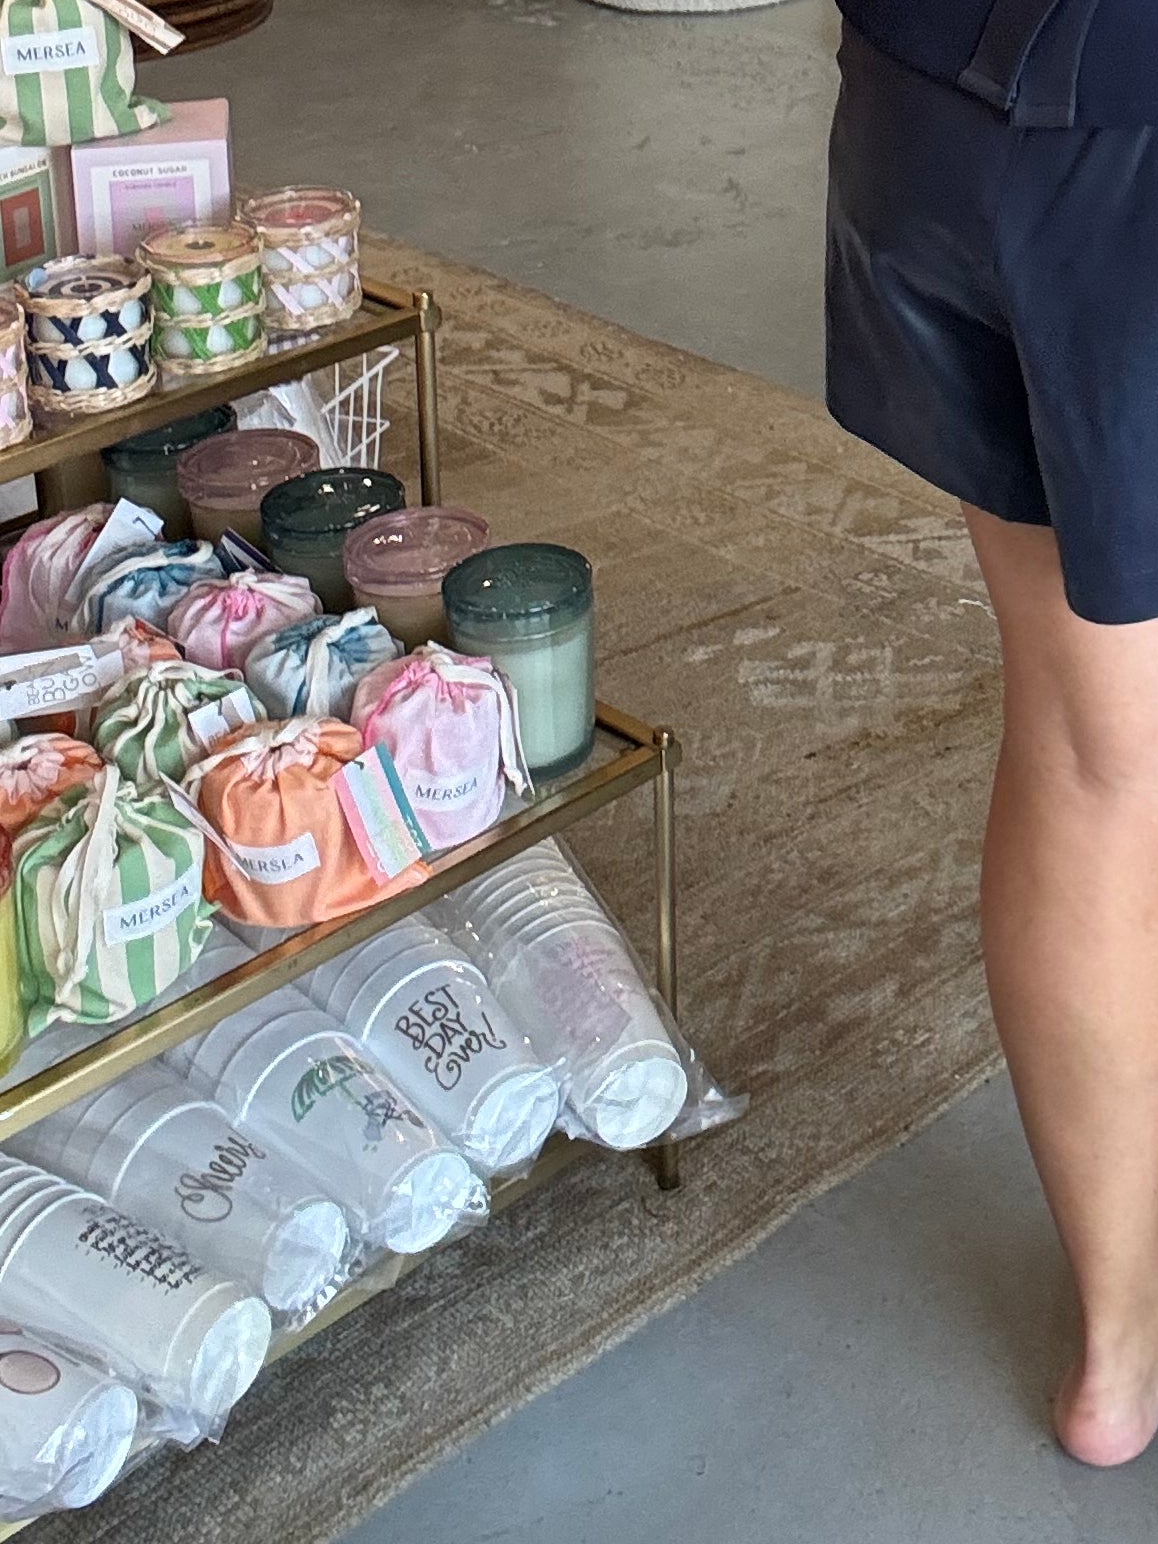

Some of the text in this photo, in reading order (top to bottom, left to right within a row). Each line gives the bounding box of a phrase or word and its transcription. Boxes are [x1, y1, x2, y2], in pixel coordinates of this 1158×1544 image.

[16, 41, 87, 62] MERSEA
[112, 165, 188, 178] COCONUT SUGAR
[415, 777, 478, 801] MERSEA
[120, 885, 189, 929] MERSEA
[394, 983, 459, 1051] BEST
[424, 1011, 468, 1060] DAY
